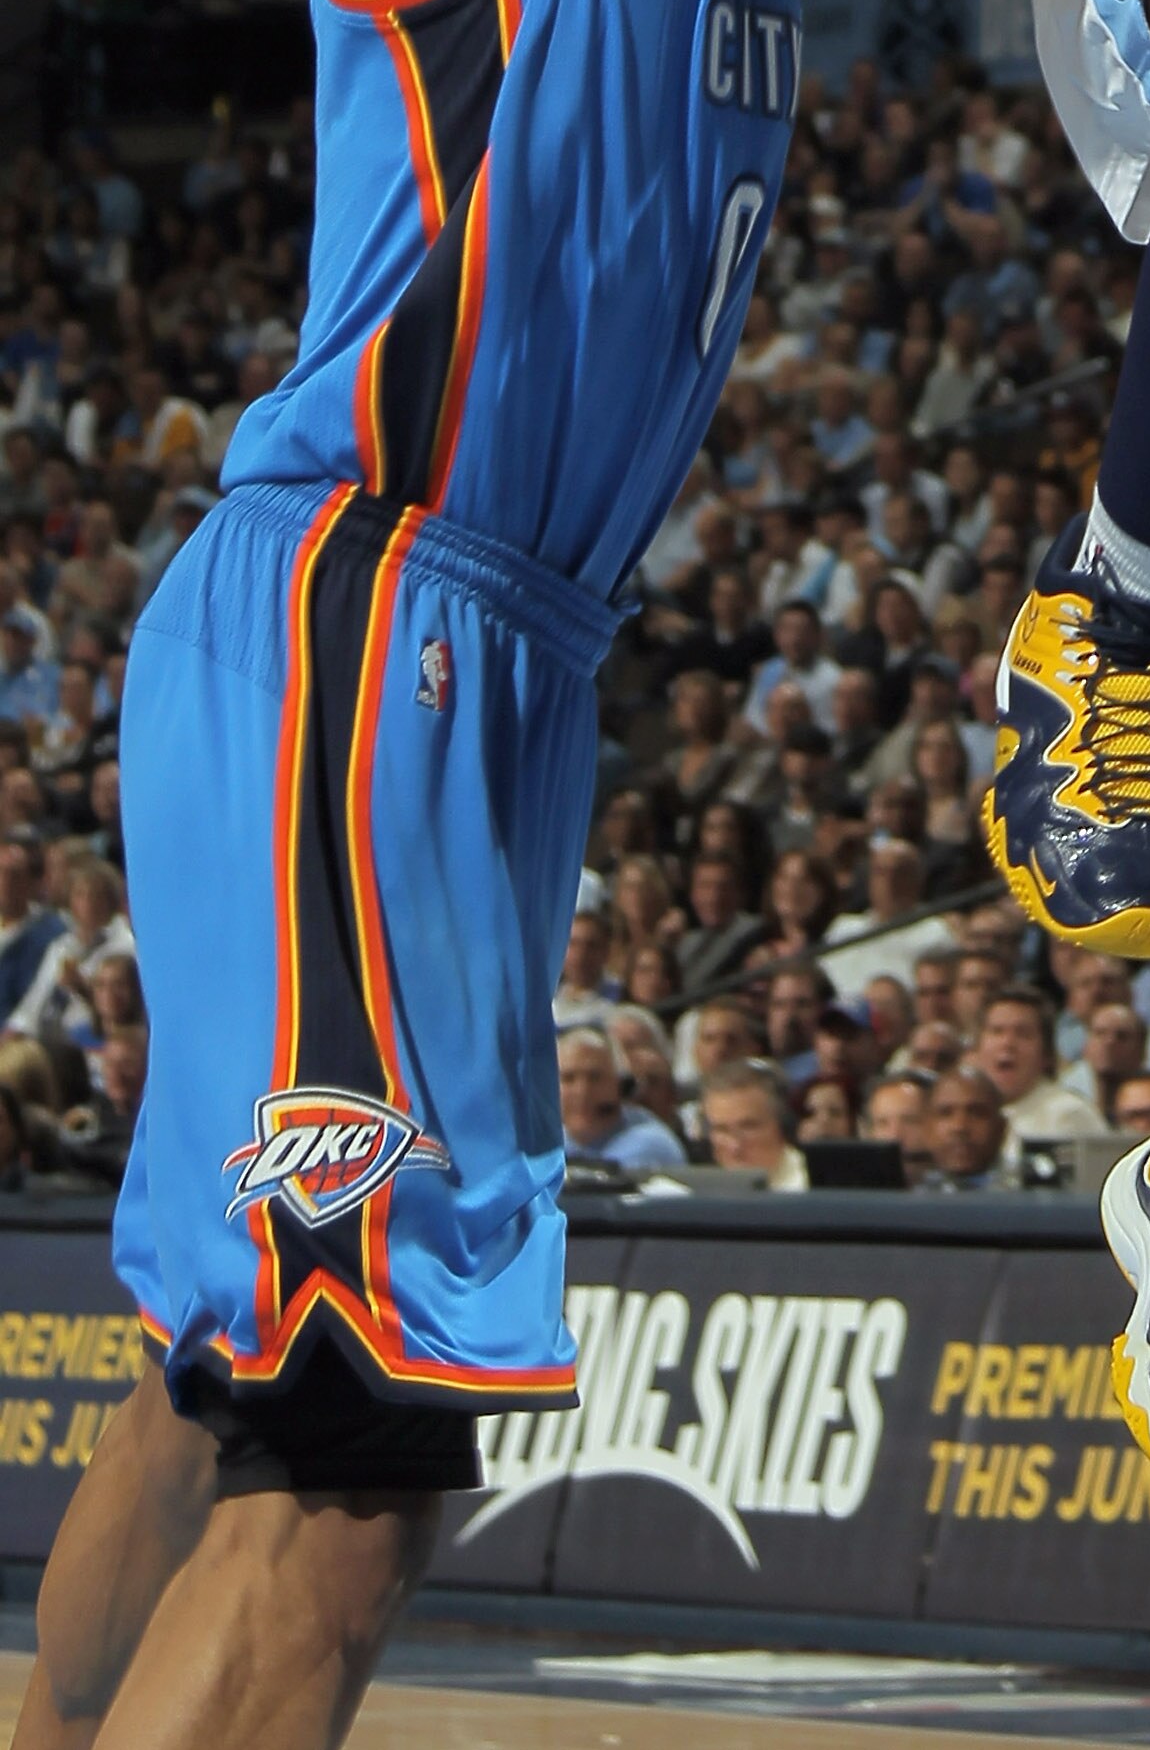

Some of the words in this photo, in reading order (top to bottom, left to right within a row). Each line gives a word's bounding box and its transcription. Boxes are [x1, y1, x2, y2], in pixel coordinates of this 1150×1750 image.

[708, 1, 802, 119] CITY
[244, 1122, 380, 1190] OKC
[675, 1292, 908, 1519] SKIES
[925, 1440, 1056, 1520] THIS
